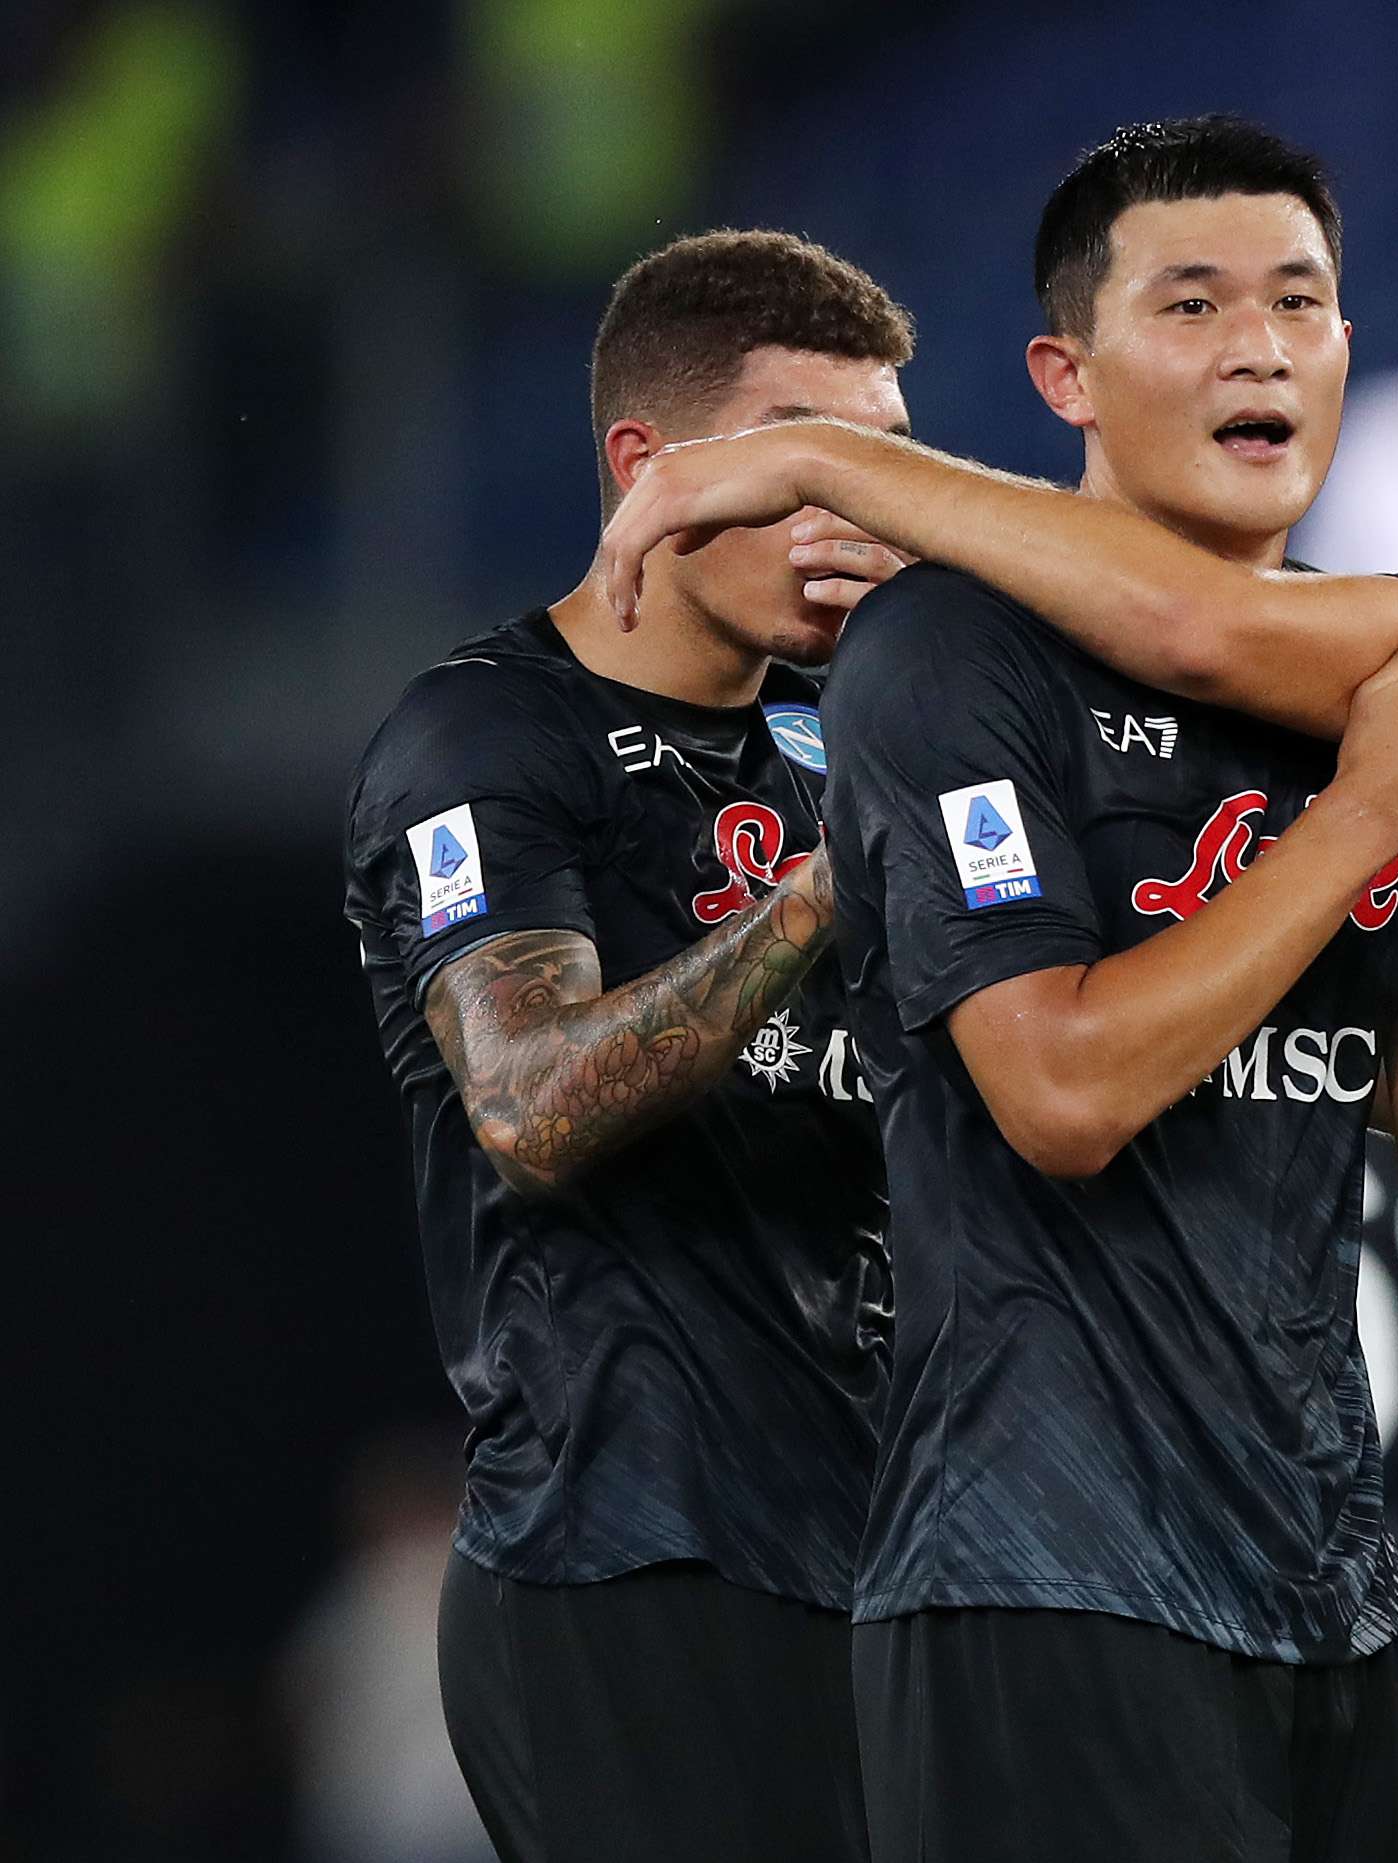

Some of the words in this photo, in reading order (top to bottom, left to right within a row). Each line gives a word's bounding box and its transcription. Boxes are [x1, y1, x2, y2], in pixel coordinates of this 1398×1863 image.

[1090, 707, 1179, 759] EA7
[608, 725, 692, 773] EA
[968, 854, 1009, 872] SERIE
[1012, 853, 1022, 863] A
[430, 879, 461, 902] SERIE
[463, 875, 473, 886] A
[994, 879, 1032, 899] TIM
[446, 899, 478, 921] TIM
[1223, 1025, 1376, 1103] MSC
